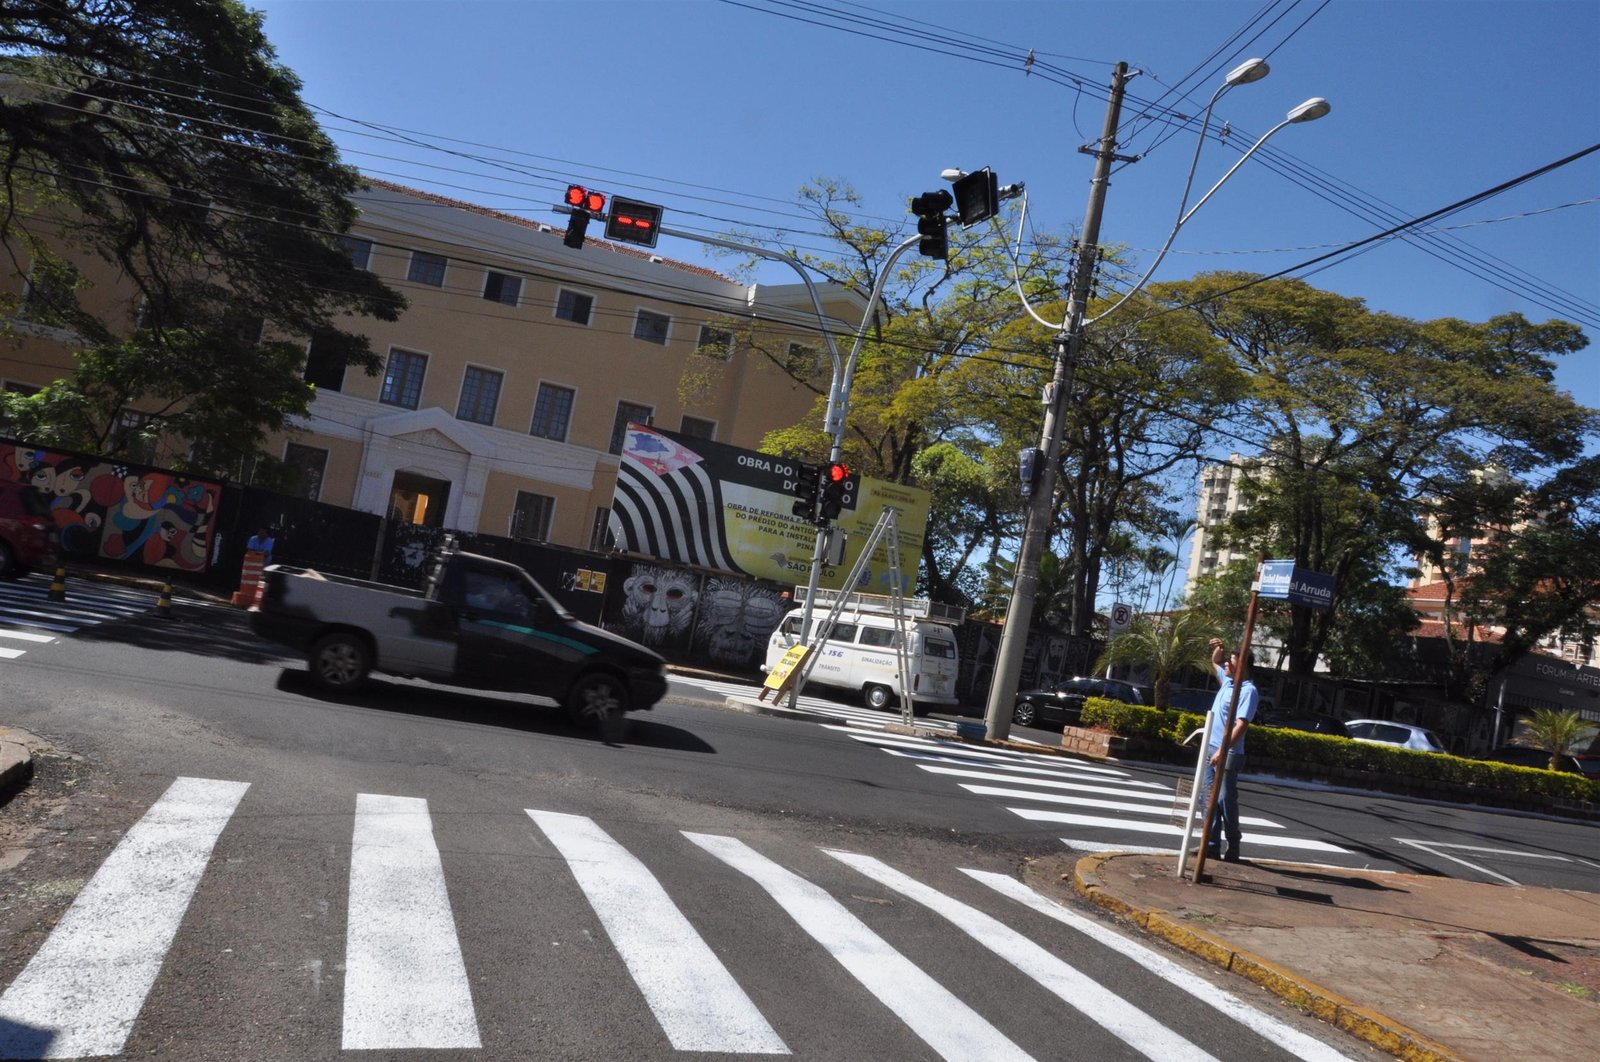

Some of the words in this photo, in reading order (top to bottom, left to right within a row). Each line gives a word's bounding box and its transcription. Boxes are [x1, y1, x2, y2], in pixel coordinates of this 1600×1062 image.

[737, 455, 771, 472] OBRA
[775, 464, 792, 476] DO
[727, 502, 747, 513] OBRA
[749, 507, 759, 515] DE
[761, 509, 794, 522] REFORMA
[735, 512, 746, 520] DO
[748, 514, 776, 527] PRÉDIO
[778, 521, 788, 530] DO
[758, 526, 778, 536] PARA
[1300, 582, 1331, 598] Arruda
